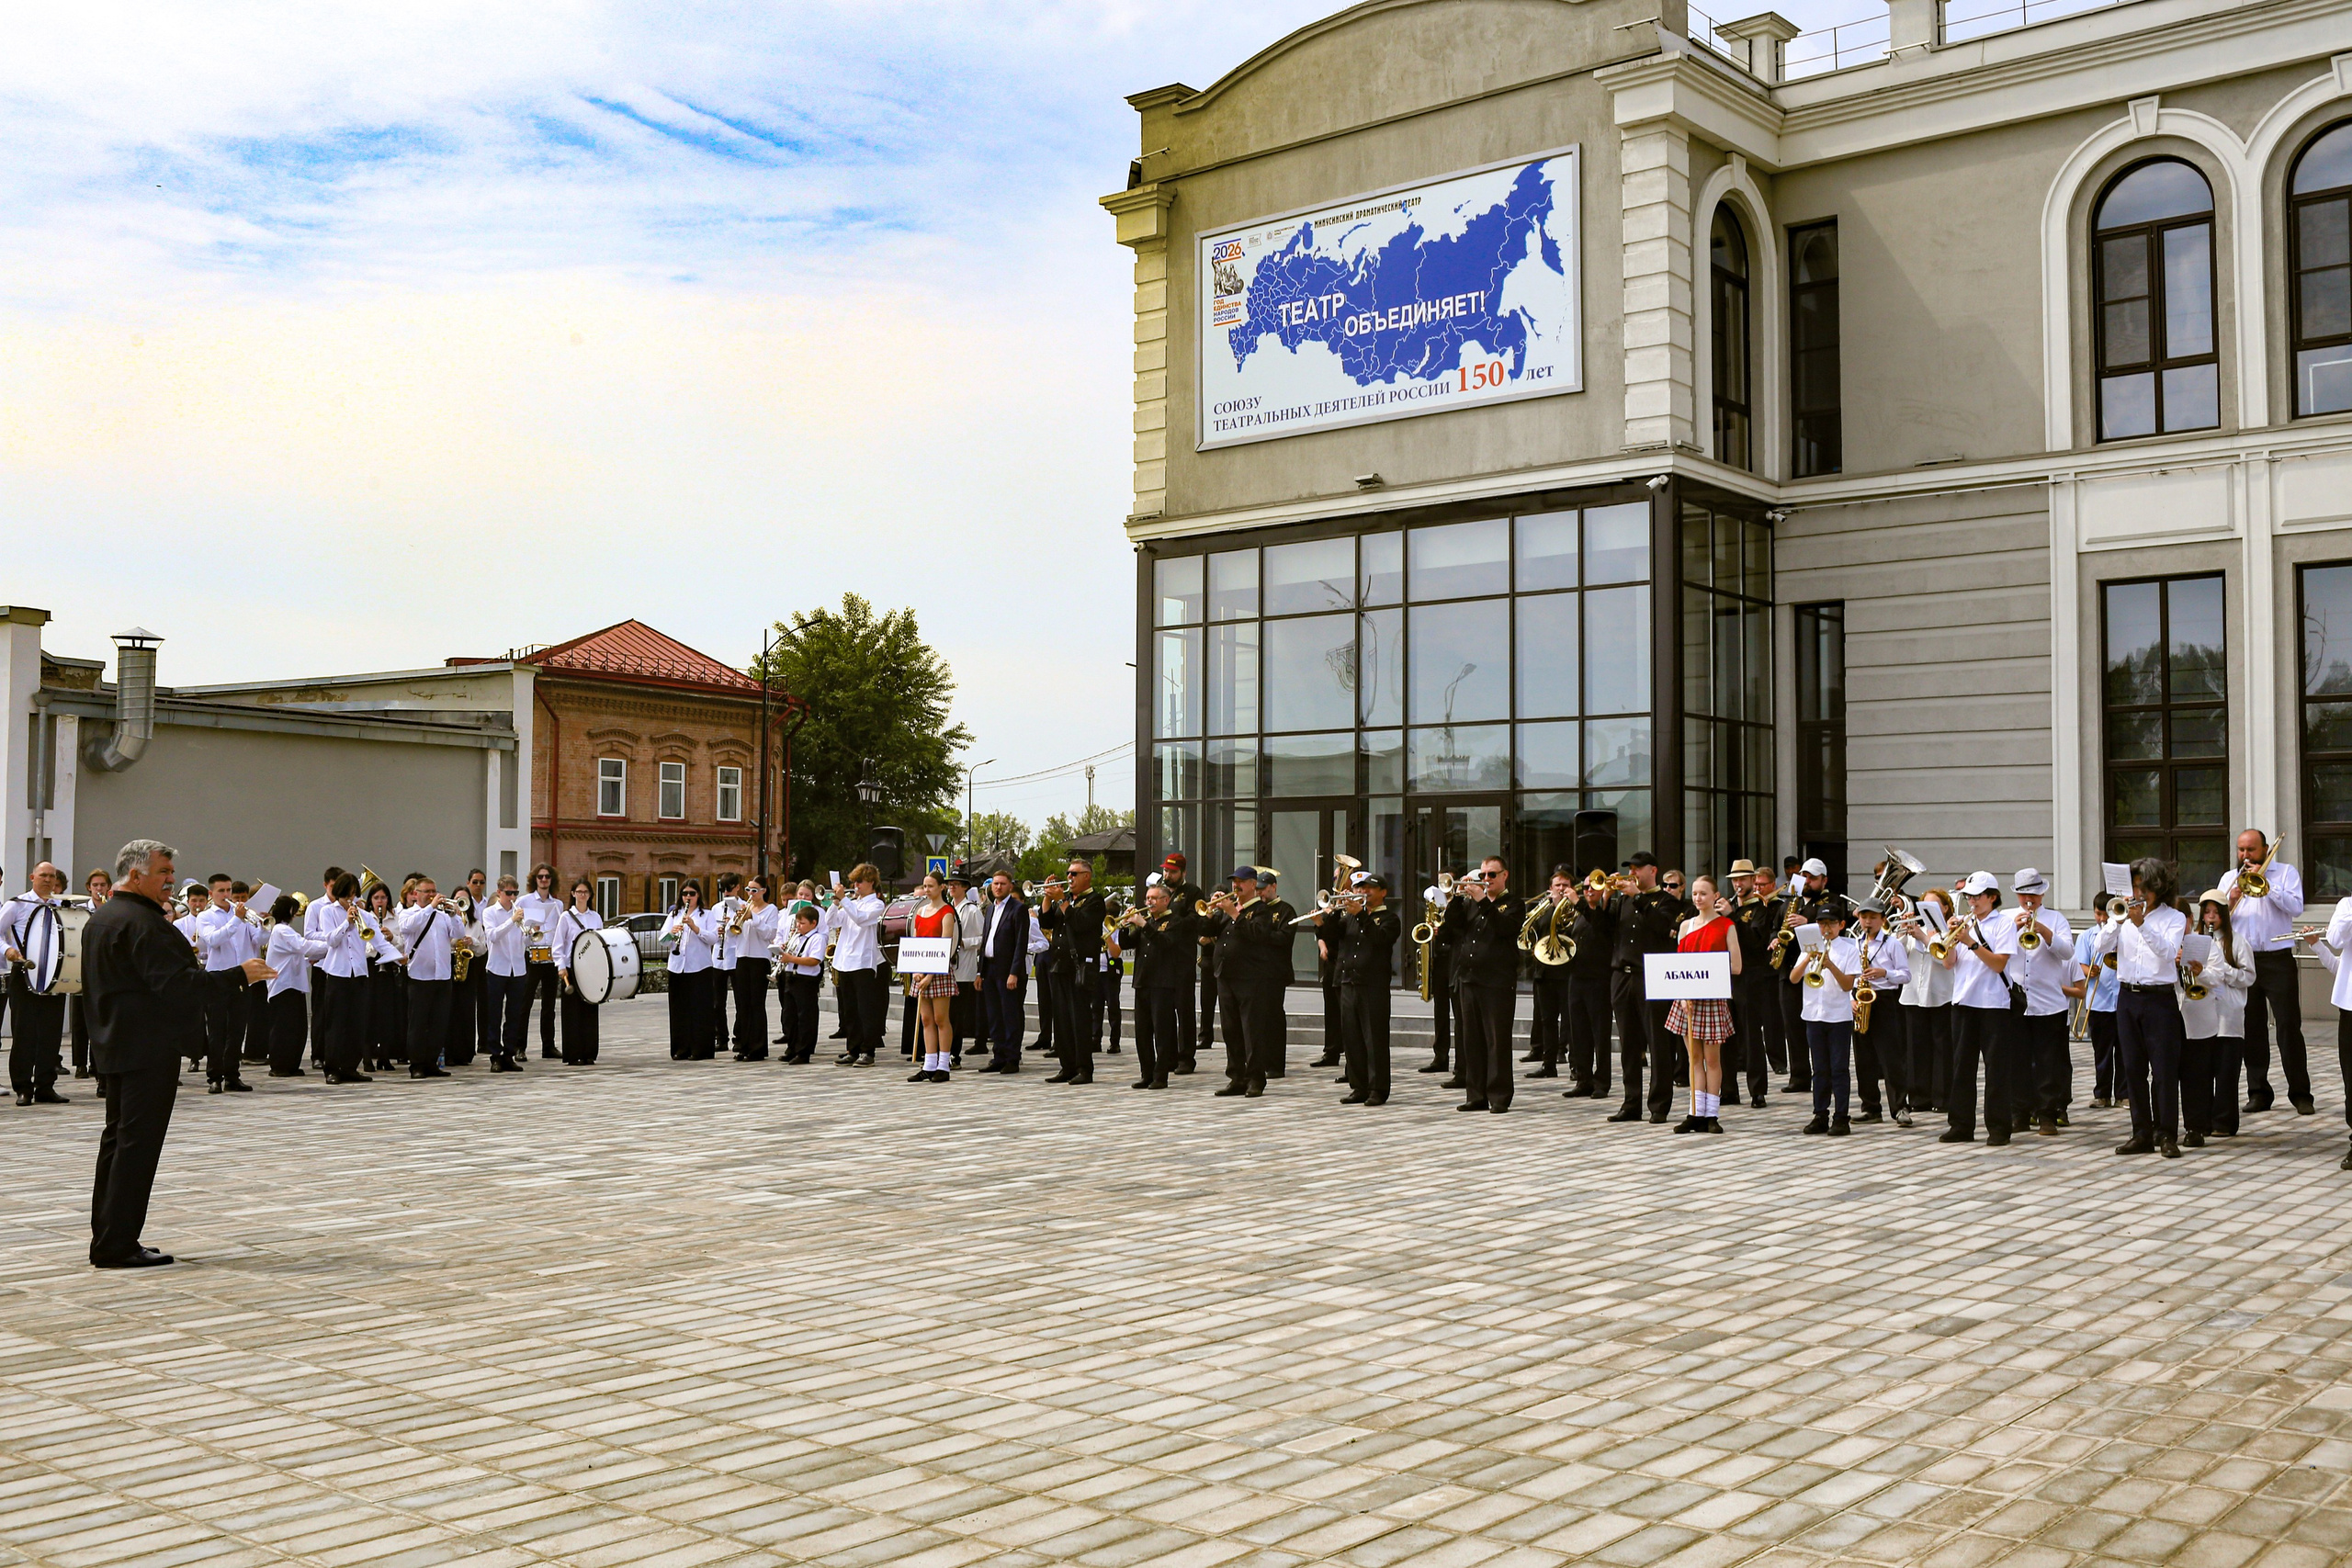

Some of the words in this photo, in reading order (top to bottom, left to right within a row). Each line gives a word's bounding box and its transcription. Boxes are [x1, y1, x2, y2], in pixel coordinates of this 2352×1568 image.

[1355, 200, 1403, 220] ДРАМАТИЧЕСКИЙ
[1405, 197, 1421, 209] ТЕАТР
[1213, 242, 1242, 260] 2026
[1214, 299, 1225, 307] ГОД
[1214, 301, 1241, 311] ЕДИНСТВА
[1278, 292, 1345, 327] ТЕАТР
[1214, 308, 1239, 317] НАРОДОВ
[1214, 314, 1236, 322] РОССИИ
[1344, 290, 1486, 337] ОБЪЕДИНЯЕТ!
[1214, 404, 1311, 432] ТЕАТРАЛЬНЫХ
[1314, 389, 1385, 418] ДЕЯТЕЛЕЙ
[1389, 381, 1450, 403] РОССИИ
[1458, 361, 1504, 392] 150
[1526, 365, 1555, 381] лет
[1214, 396, 1261, 415] СОЮЗУ
[902, 950, 946, 958] МИНУСИНСК
[1664, 970, 1709, 980] АБАКАН
